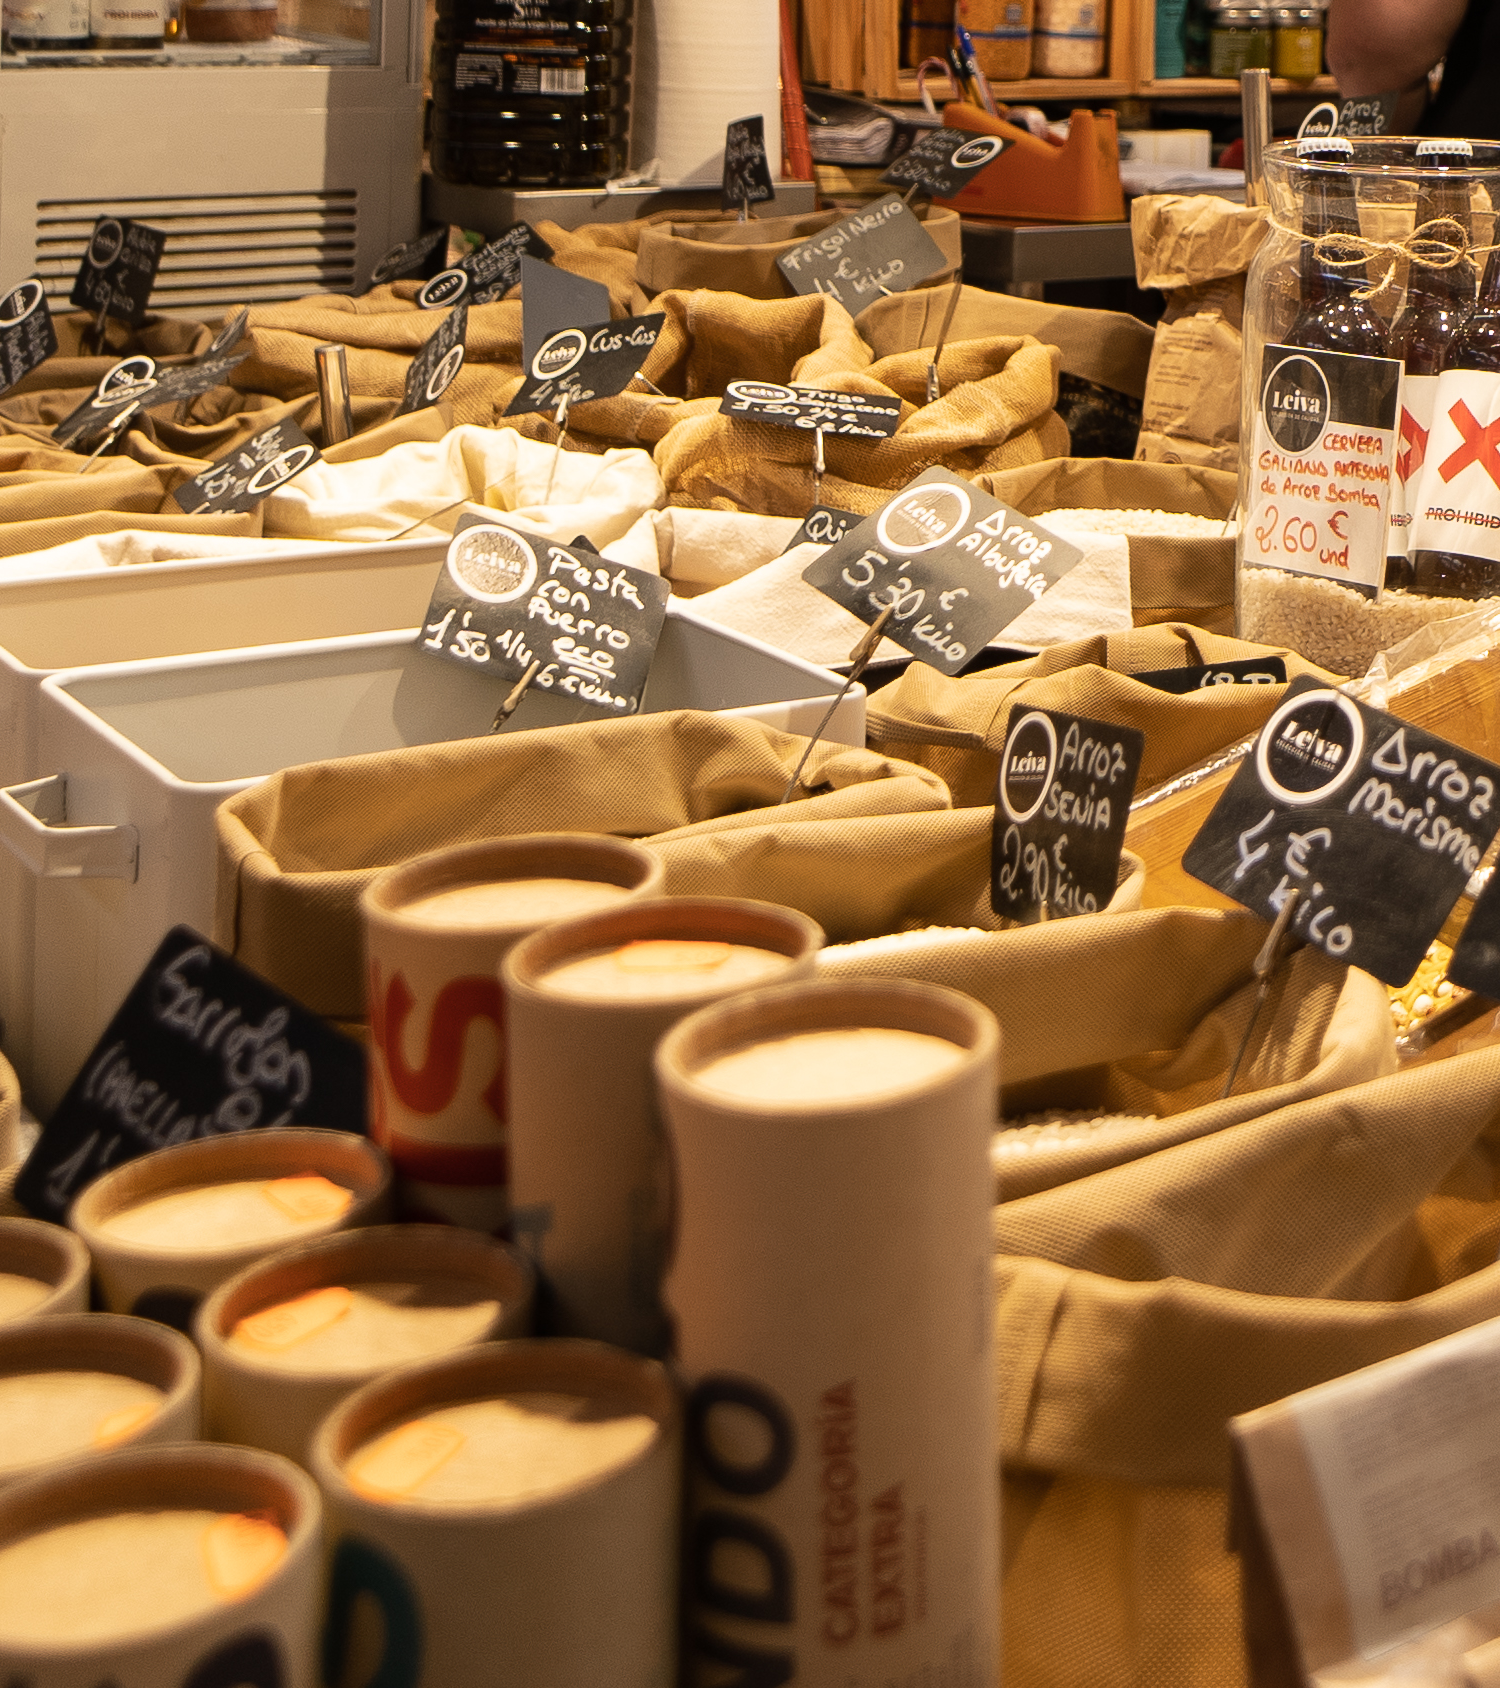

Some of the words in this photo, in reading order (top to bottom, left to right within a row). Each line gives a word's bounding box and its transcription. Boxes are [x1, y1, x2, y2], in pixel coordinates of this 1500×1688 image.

[1272, 390, 1321, 415] Leiva
[1260, 476, 1277, 494] de
[1282, 477, 1321, 500] Arroz
[1324, 482, 1381, 510] Bomba
[974, 509, 1053, 565] Arroz
[1254, 504, 1318, 553] 2.60
[1327, 510, 1349, 540] €
[1319, 544, 1350, 569] und
[548, 546, 645, 610] Pasta
[956, 532, 1048, 601] Albufera
[538, 579, 591, 612] con
[938, 588, 970, 611] €
[552, 636, 615, 669] eco
[1010, 748, 1047, 774] Leiva
[1056, 720, 1127, 785] Arroz
[1281, 720, 1343, 763] Leiva
[1370, 726, 1496, 820] Arroz
[999, 822, 1051, 902] 2.90
[1235, 809, 1275, 880] 4
[1284, 826, 1332, 878] €
[871, 1483, 906, 1641] EXTRA
